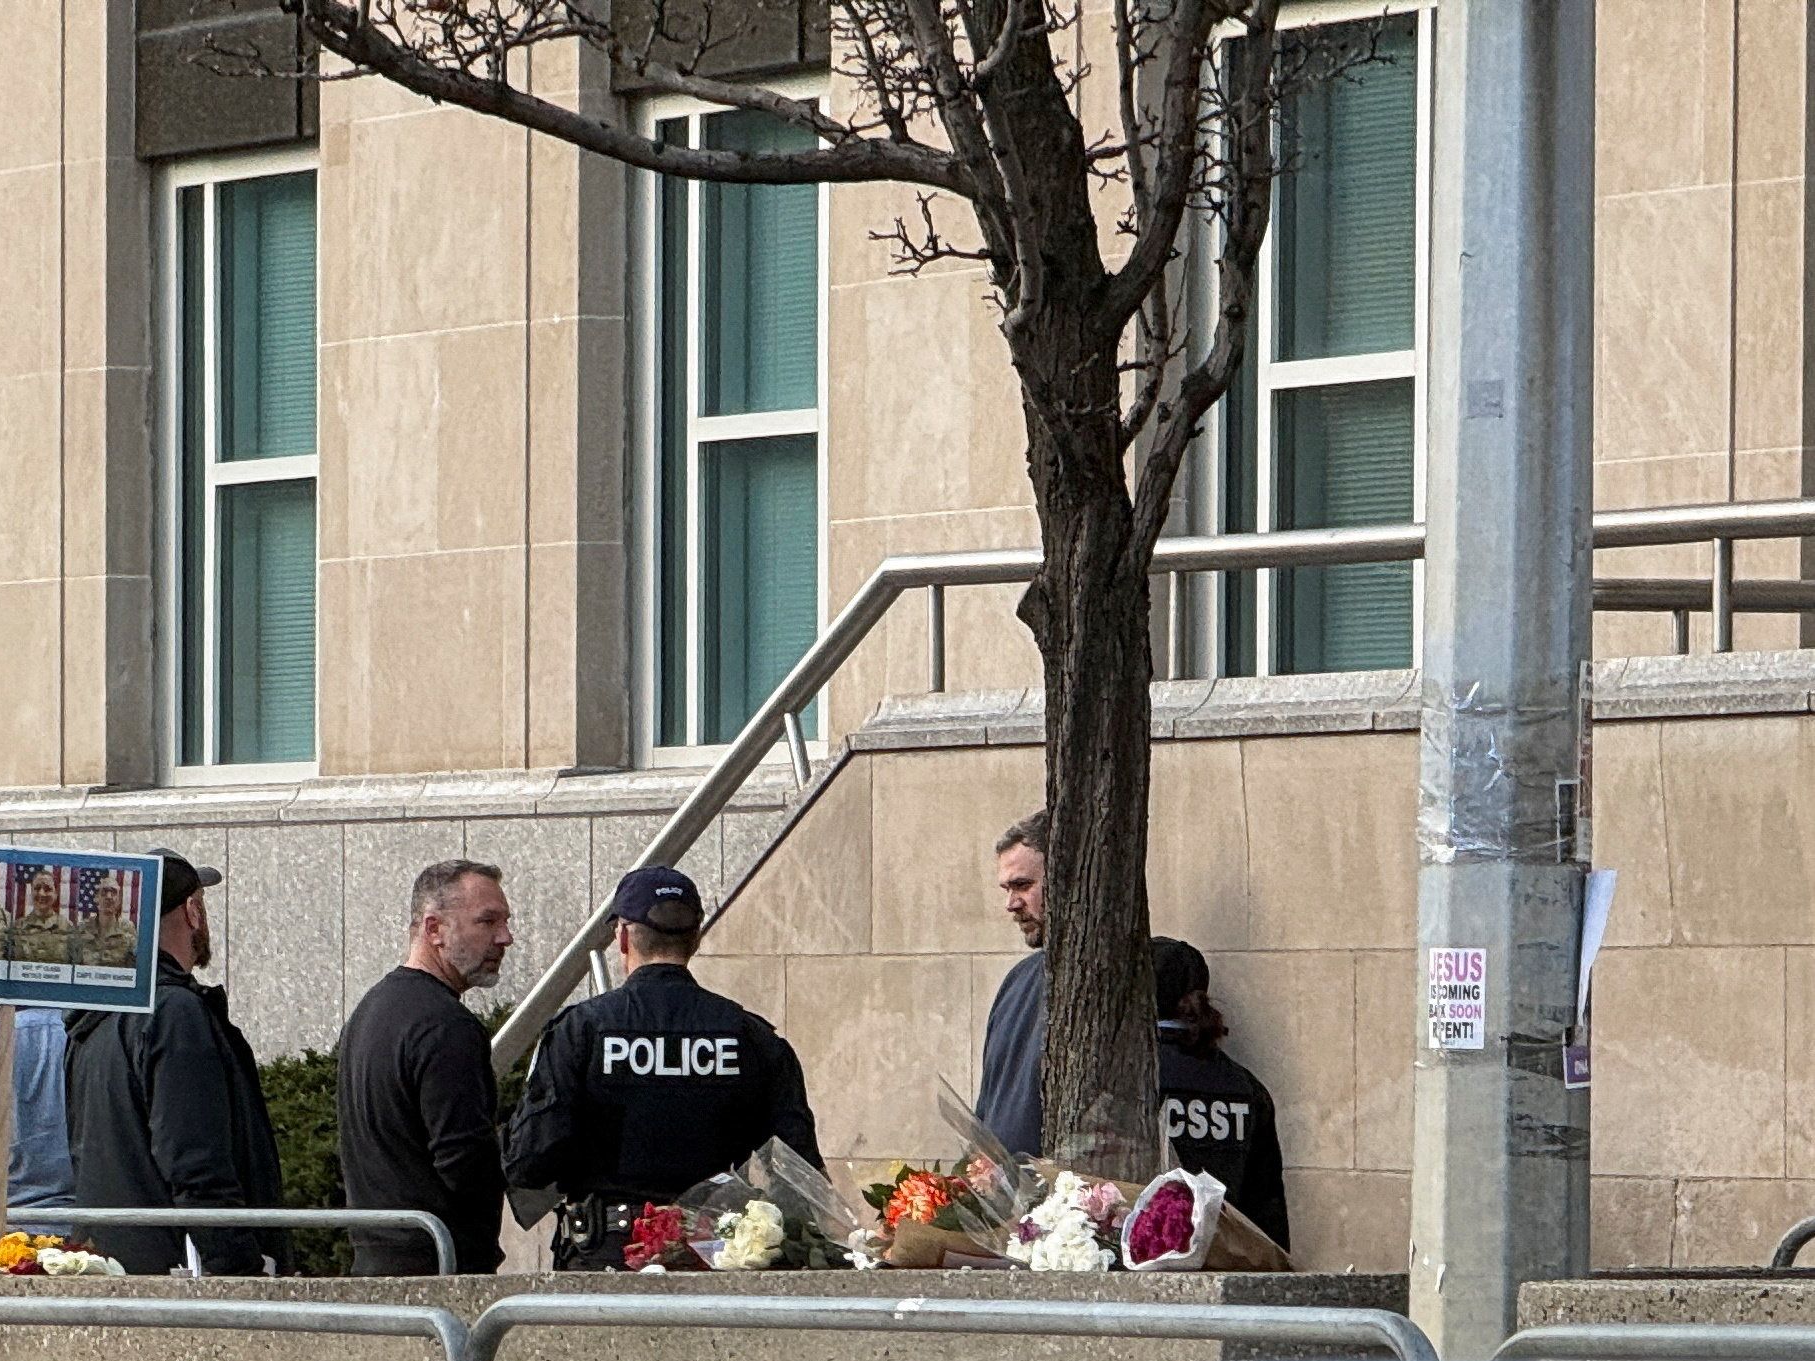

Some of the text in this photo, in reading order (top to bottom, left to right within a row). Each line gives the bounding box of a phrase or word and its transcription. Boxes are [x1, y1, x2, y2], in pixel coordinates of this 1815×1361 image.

[1430, 951, 1483, 983] JESUS
[1449, 1003, 1483, 1020] SOON
[602, 1036, 741, 1076] POLICE
[1164, 1098, 1250, 1141] CSST
